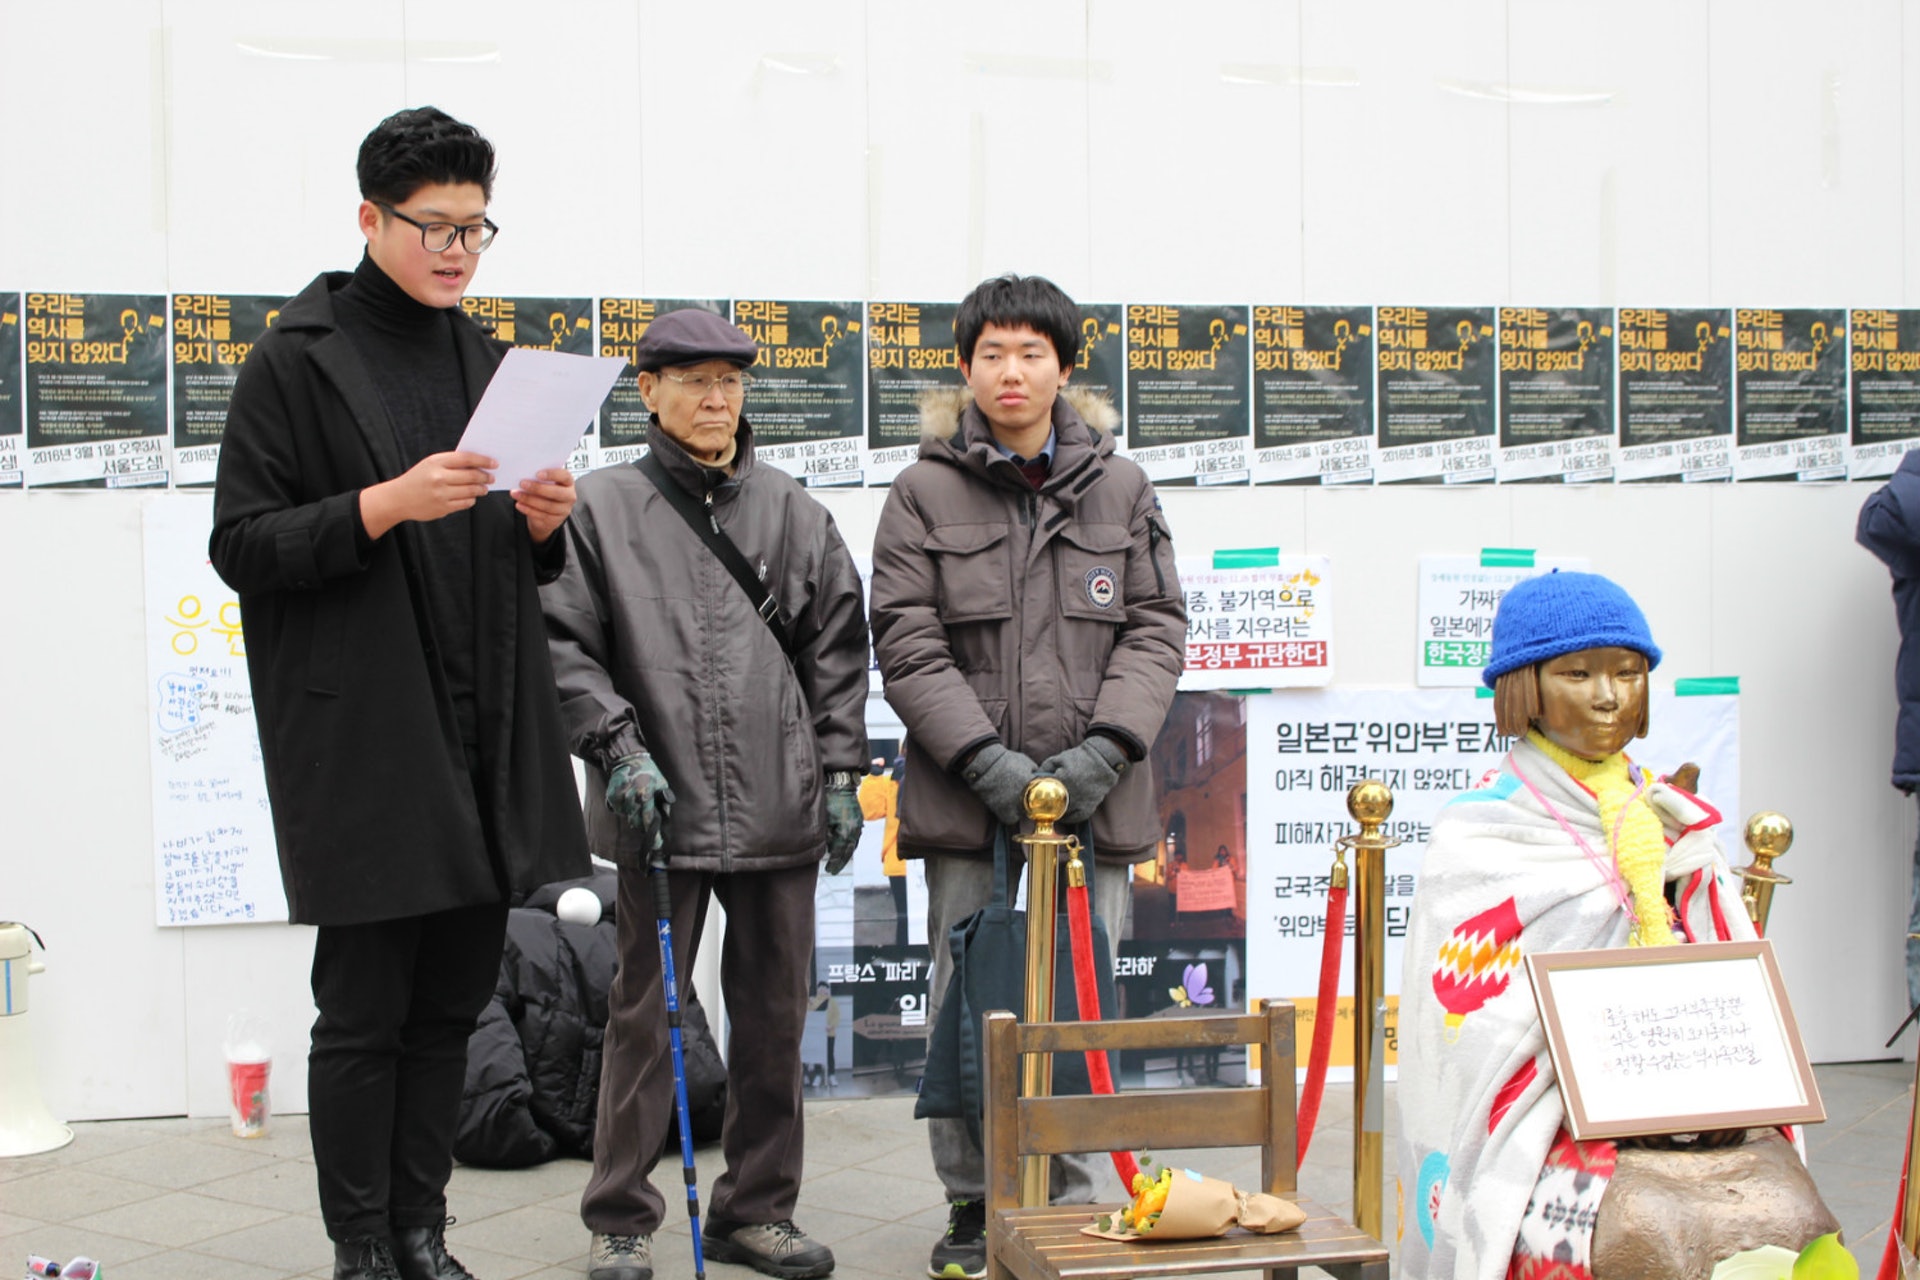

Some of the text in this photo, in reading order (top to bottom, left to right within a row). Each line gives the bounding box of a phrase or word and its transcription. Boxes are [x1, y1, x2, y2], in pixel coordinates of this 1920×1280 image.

[27, 294, 84, 316] 우리는
[174, 295, 231, 316] 우리는
[461, 298, 515, 318] 우리는
[602, 298, 655, 320] 우리는
[736, 301, 788, 321] 우리는
[869, 303, 920, 323] 우리는
[1128, 306, 1179, 325] 우리는
[1254, 306, 1304, 326] 우리는
[1379, 307, 1428, 327] 우리는
[1500, 308, 1548, 328] 우리는
[1620, 309, 1668, 328] 우리는
[1737, 310, 1784, 329] 우리는
[1852, 310, 1898, 328] 우리는
[28, 318, 85, 339] 역사를
[174, 318, 231, 340] 역사를
[869, 326, 920, 346] 역사를
[1128, 328, 1179, 348] 역사를
[1255, 328, 1304, 348] 역사를
[1379, 329, 1428, 349] 역사를
[1501, 329, 1548, 349] 역사를
[1620, 330, 1668, 350] 역사를
[1738, 331, 1784, 350] 역사를
[1852, 331, 1898, 350] 역사를
[28, 341, 128, 364] 잊지 않았다
[175, 342, 212, 364] 잊지
[775, 348, 829, 368] 않았다
[869, 349, 960, 369] 잊지 않았다
[1129, 350, 1218, 371] 잊지 않았다
[1255, 350, 1341, 371] 잊지 않았다
[1380, 351, 1463, 371] 잊지 않았다
[1502, 351, 1583, 371] 잊지 않았다
[1621, 352, 1702, 371] 잊지 않았다
[1738, 352, 1817, 371] 잊지 않았다
[1853, 352, 1883, 371] 잊지
[33, 447, 71, 463] 2016년
[74, 445, 94, 459] 3월
[119, 439, 161, 455] 오후3시
[180, 447, 217, 464] 2016년
[873, 449, 908, 464] 2016년
[1132, 447, 1167, 464] 2016년
[103, 455, 164, 475] 서울도심!
[804, 456, 859, 474] 서울도심!
[1194, 454, 1246, 474] 서울도심!
[1319, 454, 1370, 473] 서울도심!
[1440, 453, 1492, 473] 서울도심!
[1219, 589, 1315, 612] 불가역으로
[1460, 589, 1506, 611] 가짜
[1237, 617, 1310, 638] 지우려는
[1246, 643, 1324, 667] 규탄한다
[1276, 769, 1312, 791] 아직
[1414, 769, 1470, 790] 않았다
[1275, 822, 1351, 844] 피해자가
[1274, 876, 1350, 898] 군국주
[828, 963, 876, 983] 프랑스
[881, 961, 921, 982] '파리'
